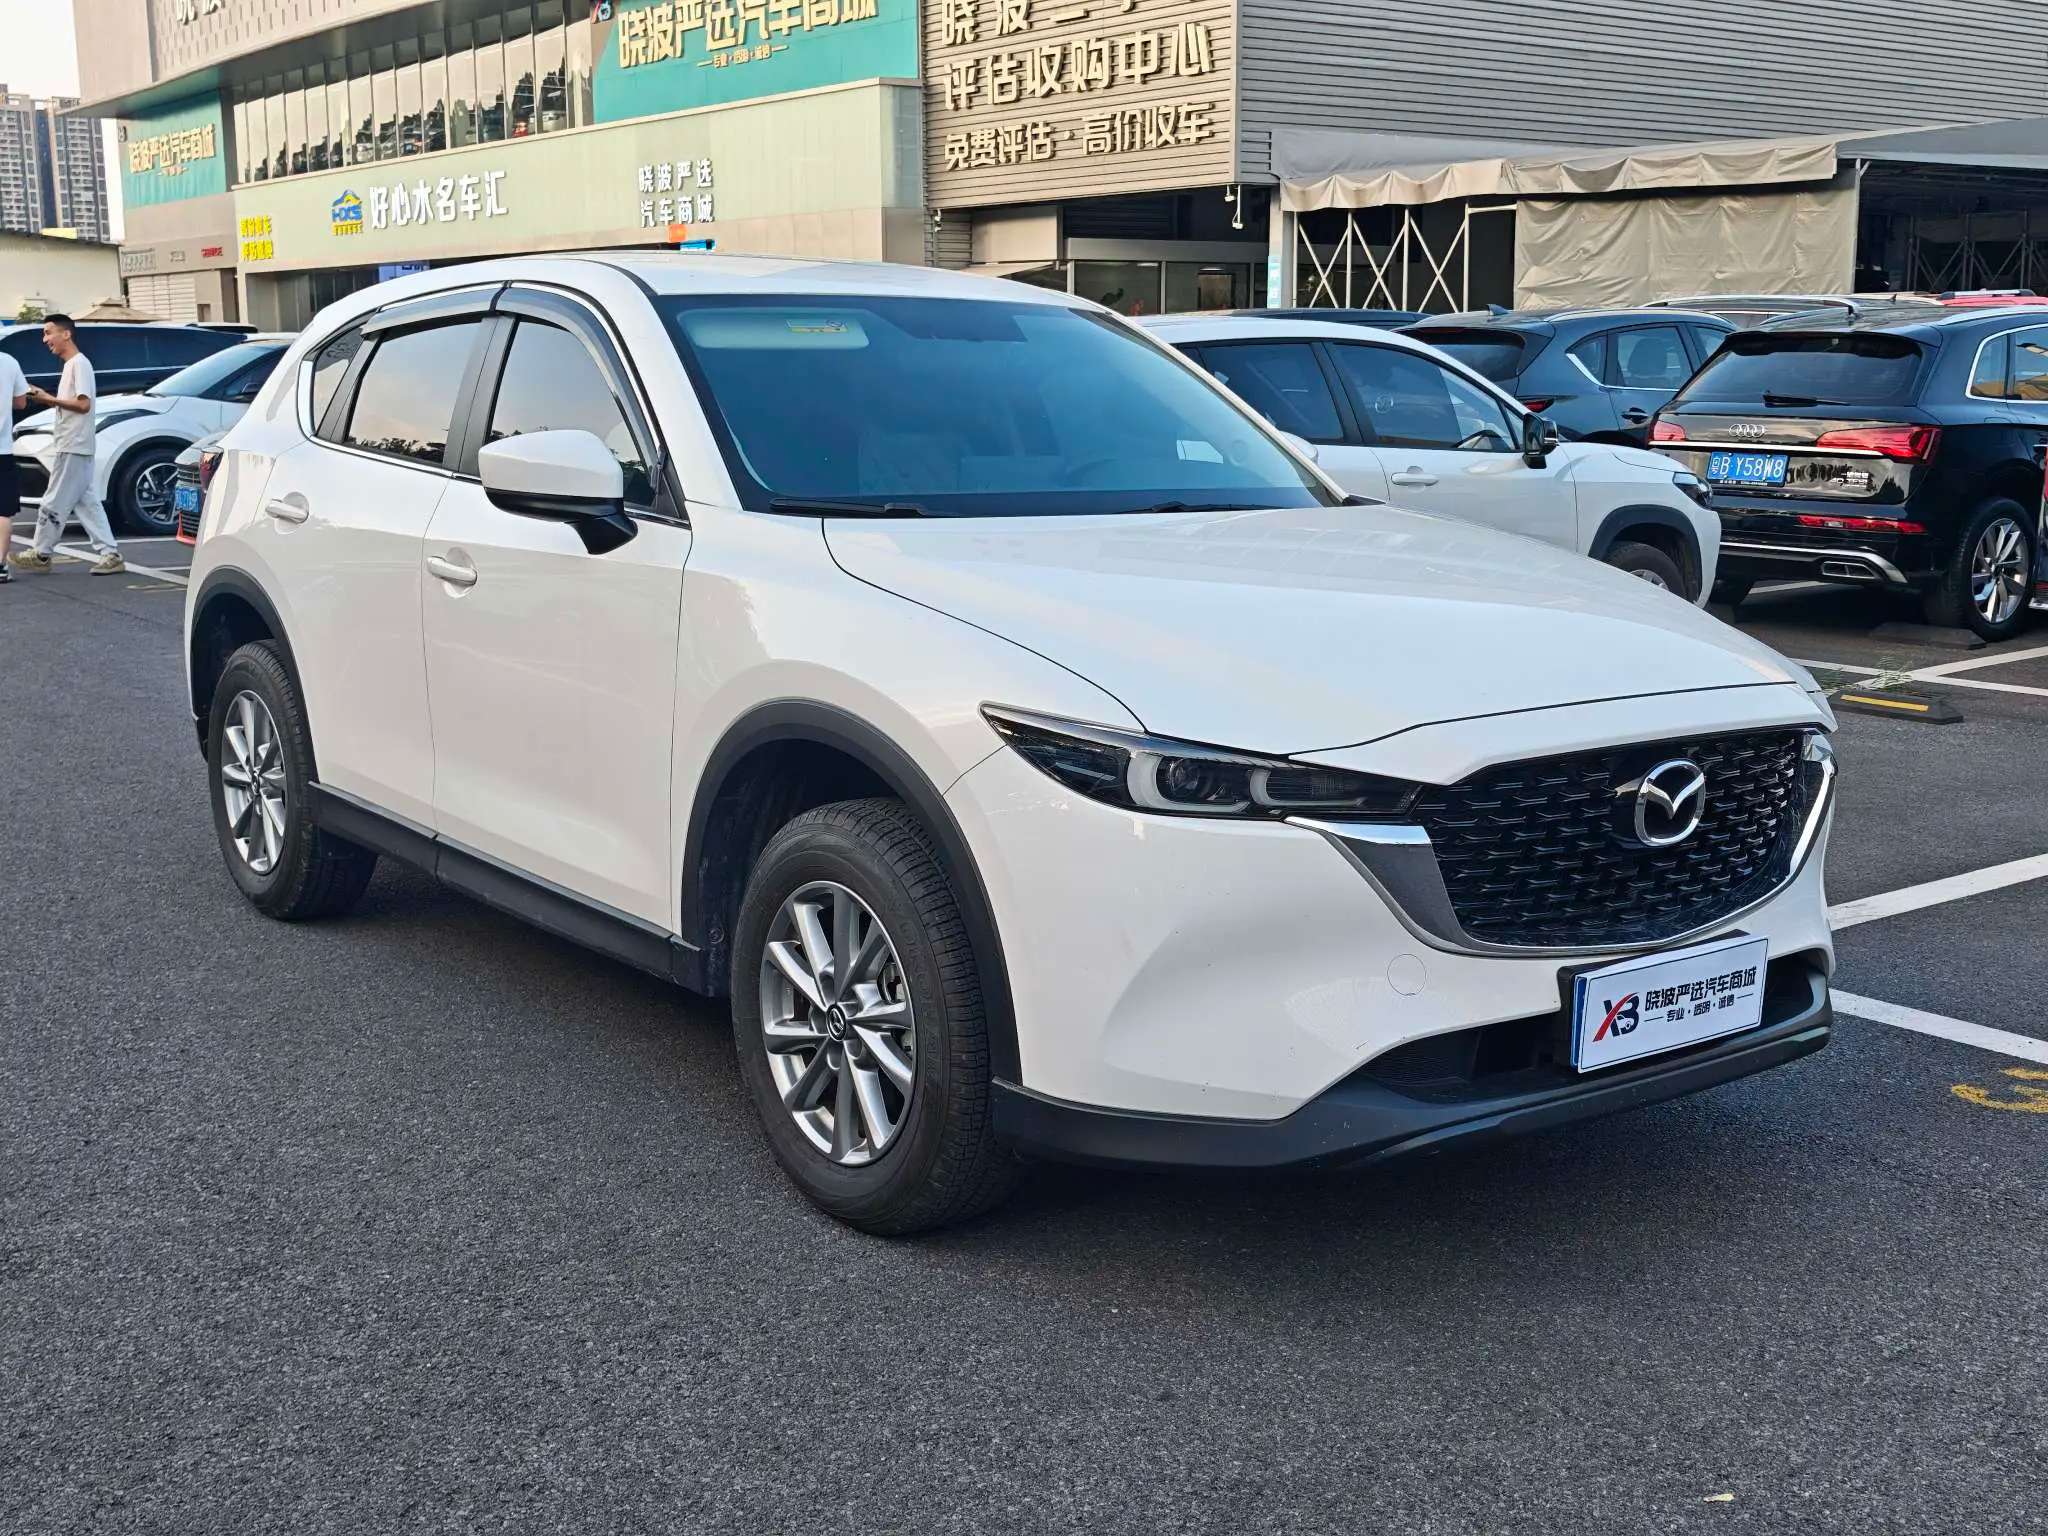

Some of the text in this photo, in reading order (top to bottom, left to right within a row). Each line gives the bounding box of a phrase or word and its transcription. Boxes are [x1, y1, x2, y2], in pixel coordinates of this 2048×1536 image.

[944, 21, 1213, 111] 评估收购中心
[944, 102, 1216, 171] 免费评估·高价收车
[369, 170, 509, 229] 好心水名车汇
[638, 157, 713, 193] 晓波严选
[639, 194, 714, 228] 汽车商城
[1644, 966, 1757, 1012] 晓波严选汽车商城
